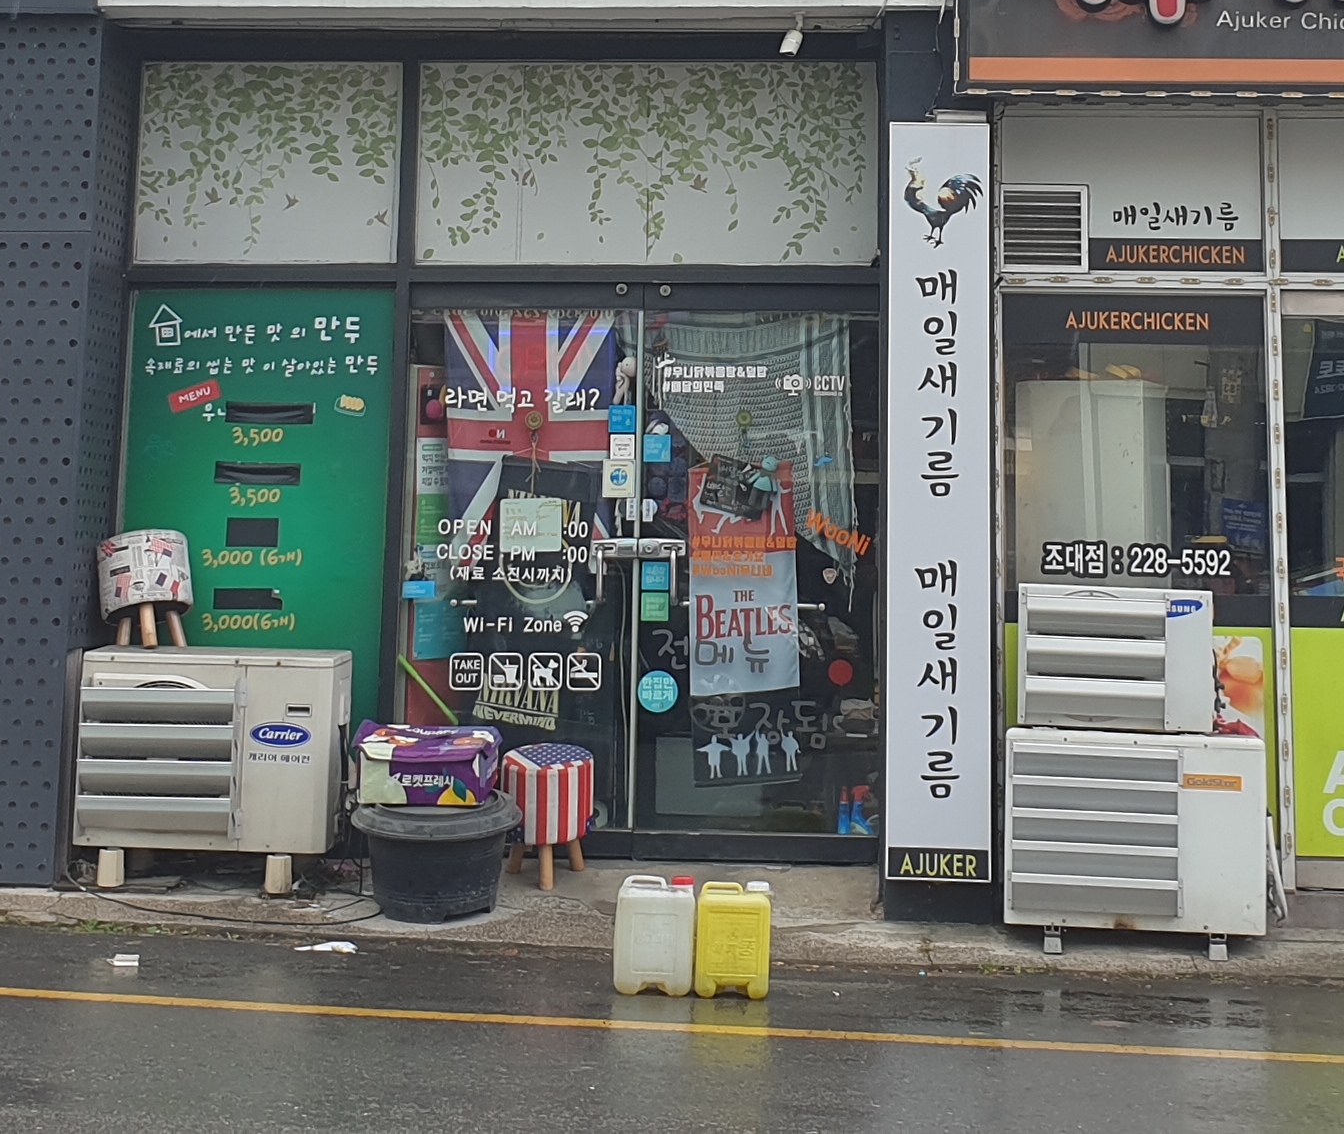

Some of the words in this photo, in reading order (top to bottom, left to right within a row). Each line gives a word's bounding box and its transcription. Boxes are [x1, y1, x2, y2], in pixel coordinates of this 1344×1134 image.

[1216, 9, 1293, 34] Ajuker
[1112, 202, 1240, 233] 매일새기름
[1105, 243, 1246, 265] AJUKERCHICKEN
[184, 326, 217, 339] 에서
[225, 325, 256, 344] 만든
[314, 316, 360, 344] 만두
[1065, 311, 1211, 330] AJUKERCHICKEN
[282, 357, 337, 377] 살아있는
[345, 355, 378, 375] 만두
[814, 376, 845, 391] CCTV
[915, 269, 960, 498] 매일새기름
[178, 386, 211, 404] MENU
[445, 386, 488, 411] 라면
[496, 387, 534, 414] 먹고
[544, 388, 601, 413] 갈래?
[232, 426, 284, 447] 3,500
[229, 487, 281, 506] 3,500
[438, 519, 492, 536] OPEN
[511, 521, 537, 536] AM
[807, 509, 871, 555] WooNi
[202, 549, 253, 568] 3,000
[260, 548, 303, 567] (6개)
[436, 545, 494, 560] CLOSE
[510, 546, 536, 561] PM
[1043, 543, 1104, 574] 조대점
[1130, 548, 1231, 575] 228-5592
[449, 565, 485, 581] (재료
[492, 567, 572, 583] 소진시까지)
[733, 590, 754, 603] THE
[463, 617, 513, 633] Wi-Fi
[523, 617, 562, 632] Zone
[453, 659, 481, 671] TAKE
[455, 673, 478, 684] OUT
[642, 677, 673, 689] 한집만
[915, 559, 962, 800] 매일새기름
[642, 690, 674, 701] 빠르게
[472, 704, 556, 731] NEVERMIND
[257, 727, 304, 742] Carrier
[247, 752, 277, 763] 캐리어
[281, 753, 311, 764] 에어컨
[401, 774, 454, 788] 로켓프레시
[1186, 777, 1237, 788] GoldStar
[900, 854, 978, 877] AJUKER
